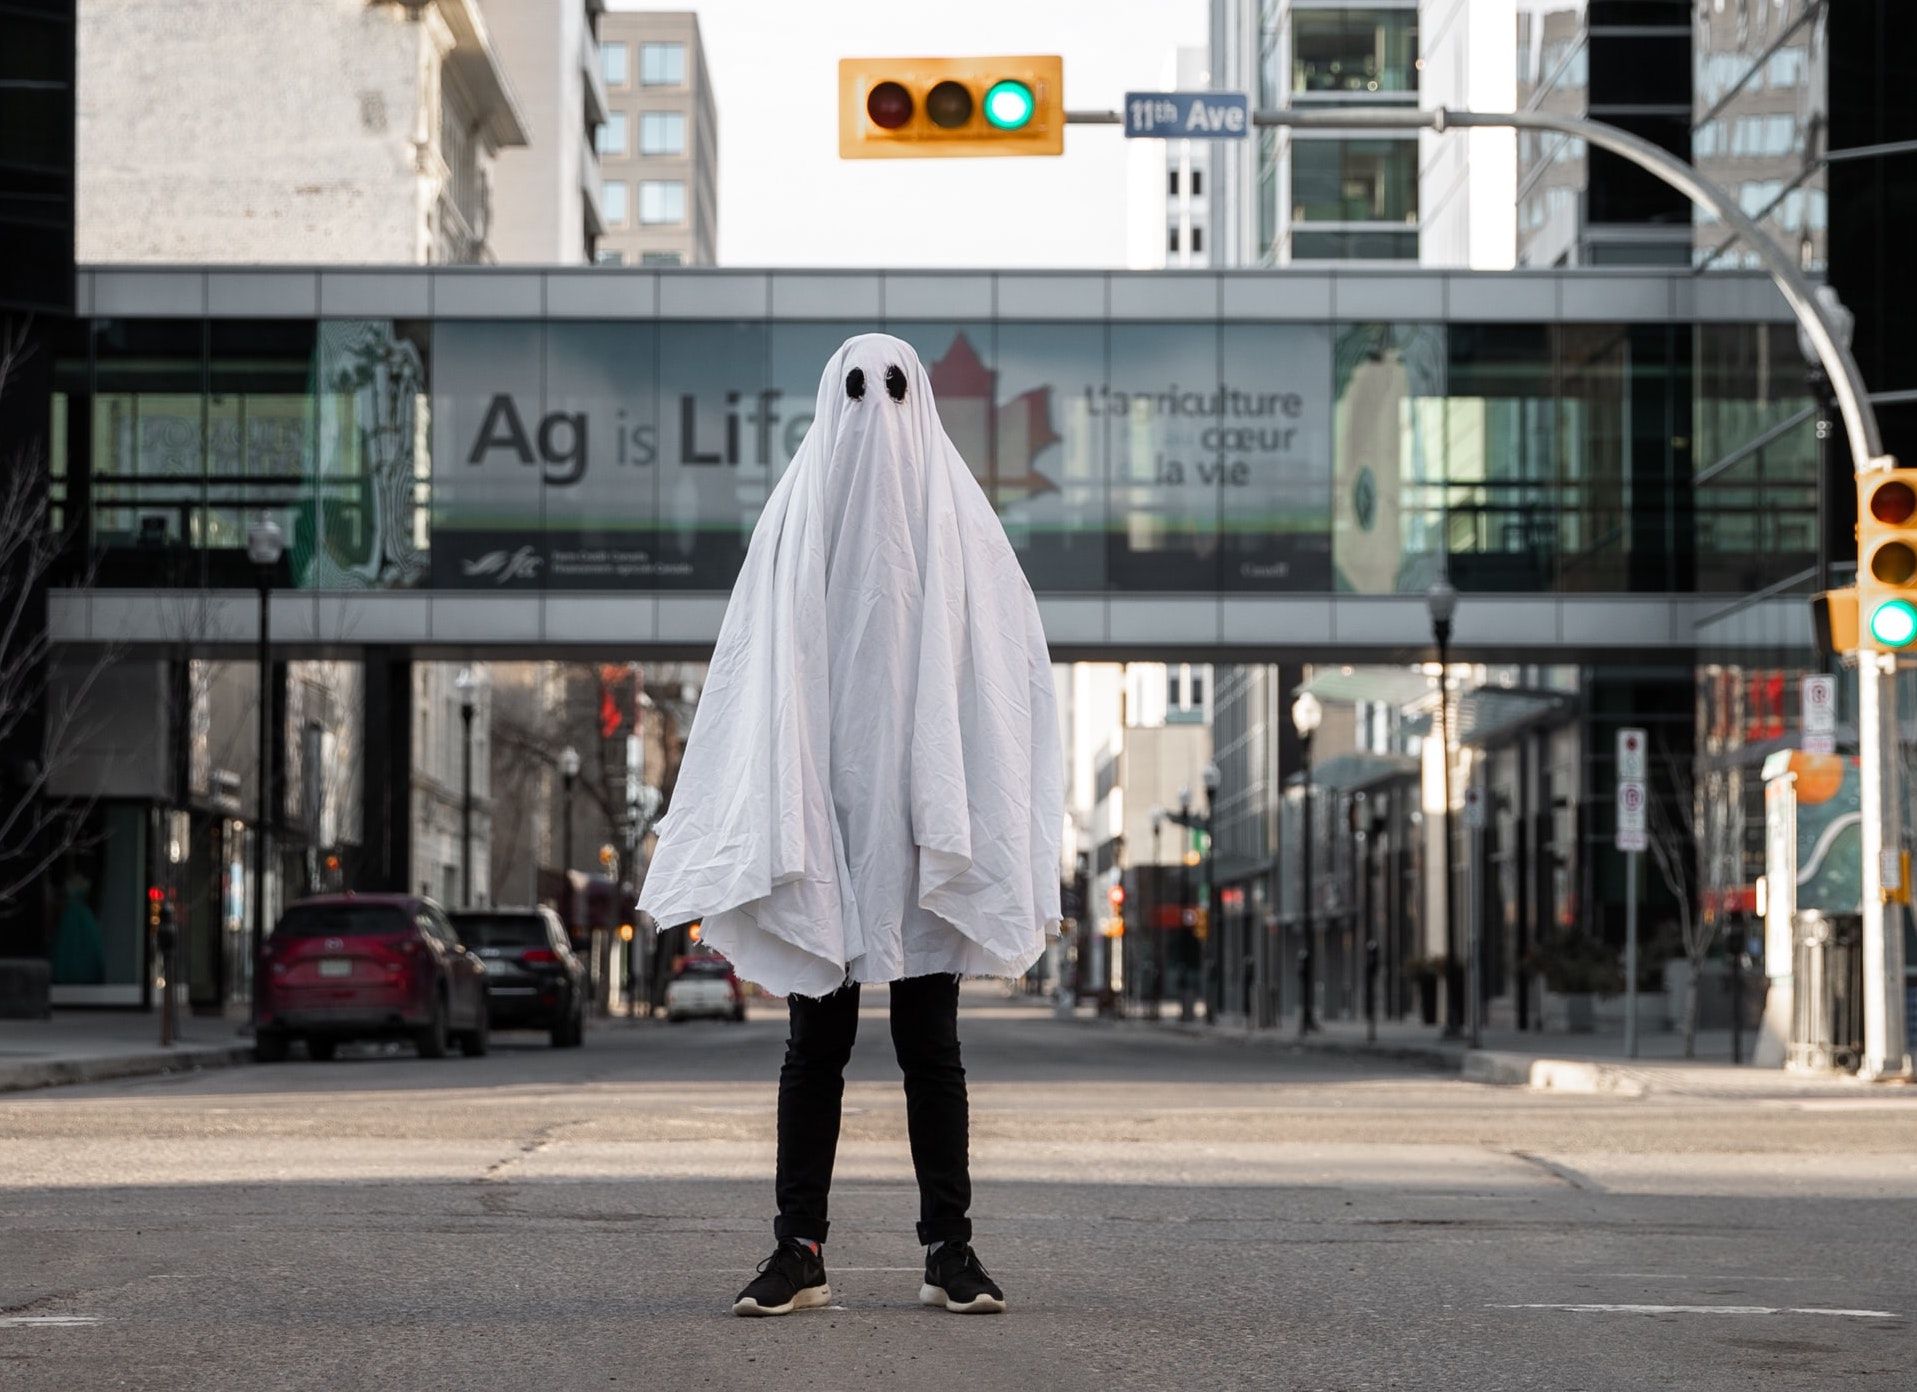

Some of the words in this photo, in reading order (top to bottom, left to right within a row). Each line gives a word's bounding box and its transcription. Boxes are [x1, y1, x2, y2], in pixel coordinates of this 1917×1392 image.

[1130, 99, 1178, 132] 11th
[1185, 99, 1245, 132] Ave
[468, 393, 588, 486] Ag
[616, 409, 658, 467] is
[1198, 455, 1250, 486] vie
